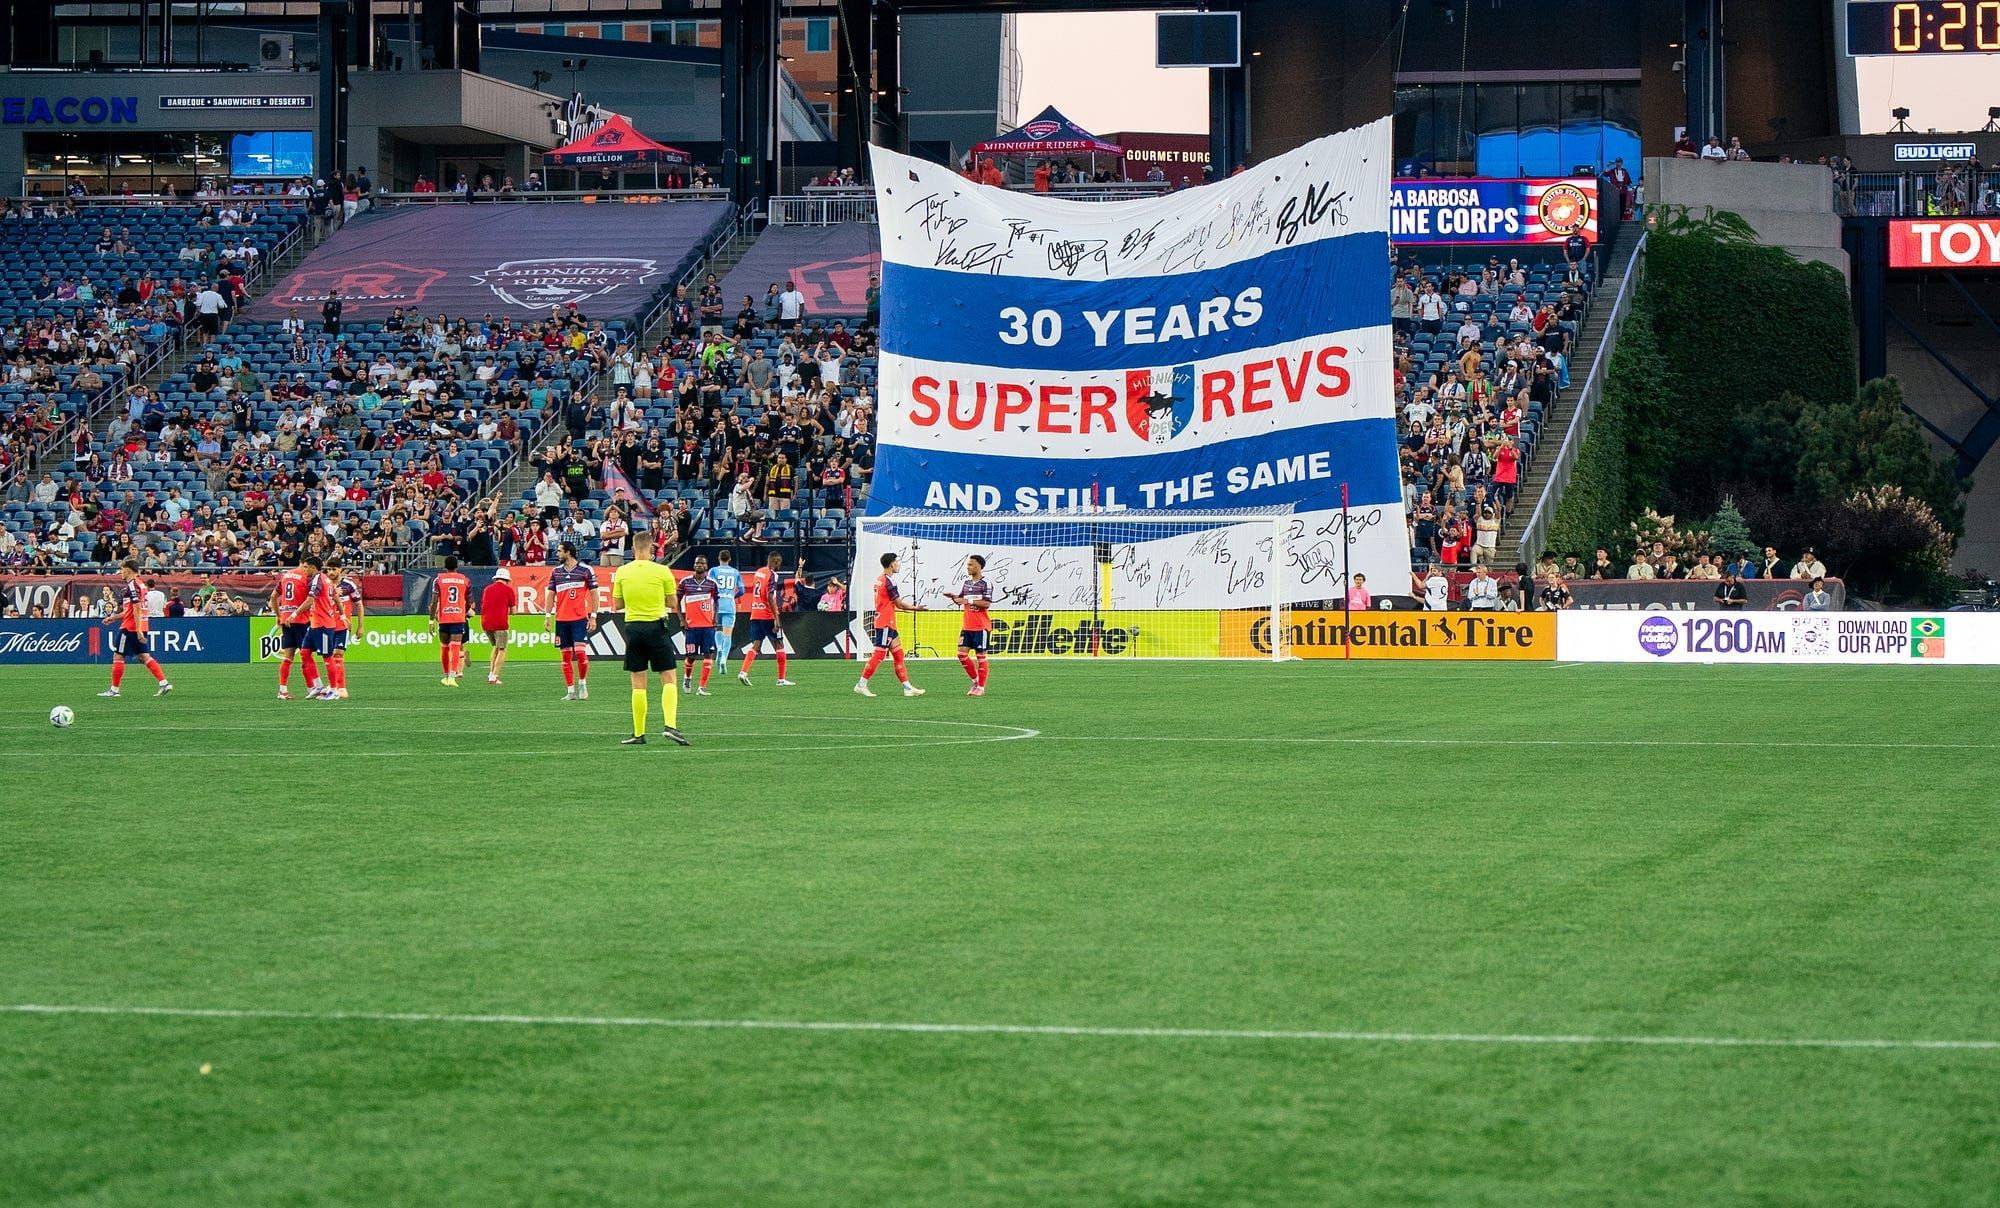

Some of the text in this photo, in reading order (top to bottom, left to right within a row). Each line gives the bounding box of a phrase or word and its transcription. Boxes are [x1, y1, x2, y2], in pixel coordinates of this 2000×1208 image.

[1893, 3, 2000, 51] 0:20
[167, 98, 305, 107] BARBEQUE SANDWICHES DESSERTS
[984, 142, 1042, 151] MIDNIGHT
[1046, 141, 1086, 149] RIDERS
[1897, 146, 1973, 158] BUD LIGHT
[576, 154, 623, 163] REBELLION
[1126, 150, 1179, 162] GOURMET
[1407, 189, 1480, 207] BARBOSA
[1437, 208, 1519, 234] CORPS
[1912, 223, 2000, 263] TOY
[501, 267, 638, 276] MIDNIGHT
[514, 277, 609, 285] RIDERS
[999, 287, 1264, 347] 30 YEARS
[1202, 346, 1352, 422] REVS
[909, 376, 1117, 435] SUPER
[924, 451, 1332, 515] AND STILL THE SAME
[285, 582, 295, 600] 8
[717, 575, 735, 590] 30
[448, 585, 459, 603] 3
[987, 614, 1129, 655] Gillette
[1457, 618, 1534, 647] Tire
[1682, 618, 1786, 653] 1260 AM
[1838, 620, 1908, 634] DOWNLOAD
[0, 632, 84, 652] Michelob
[366, 630, 434, 648] Quicker
[1838, 636, 1908, 653] OUR APP
